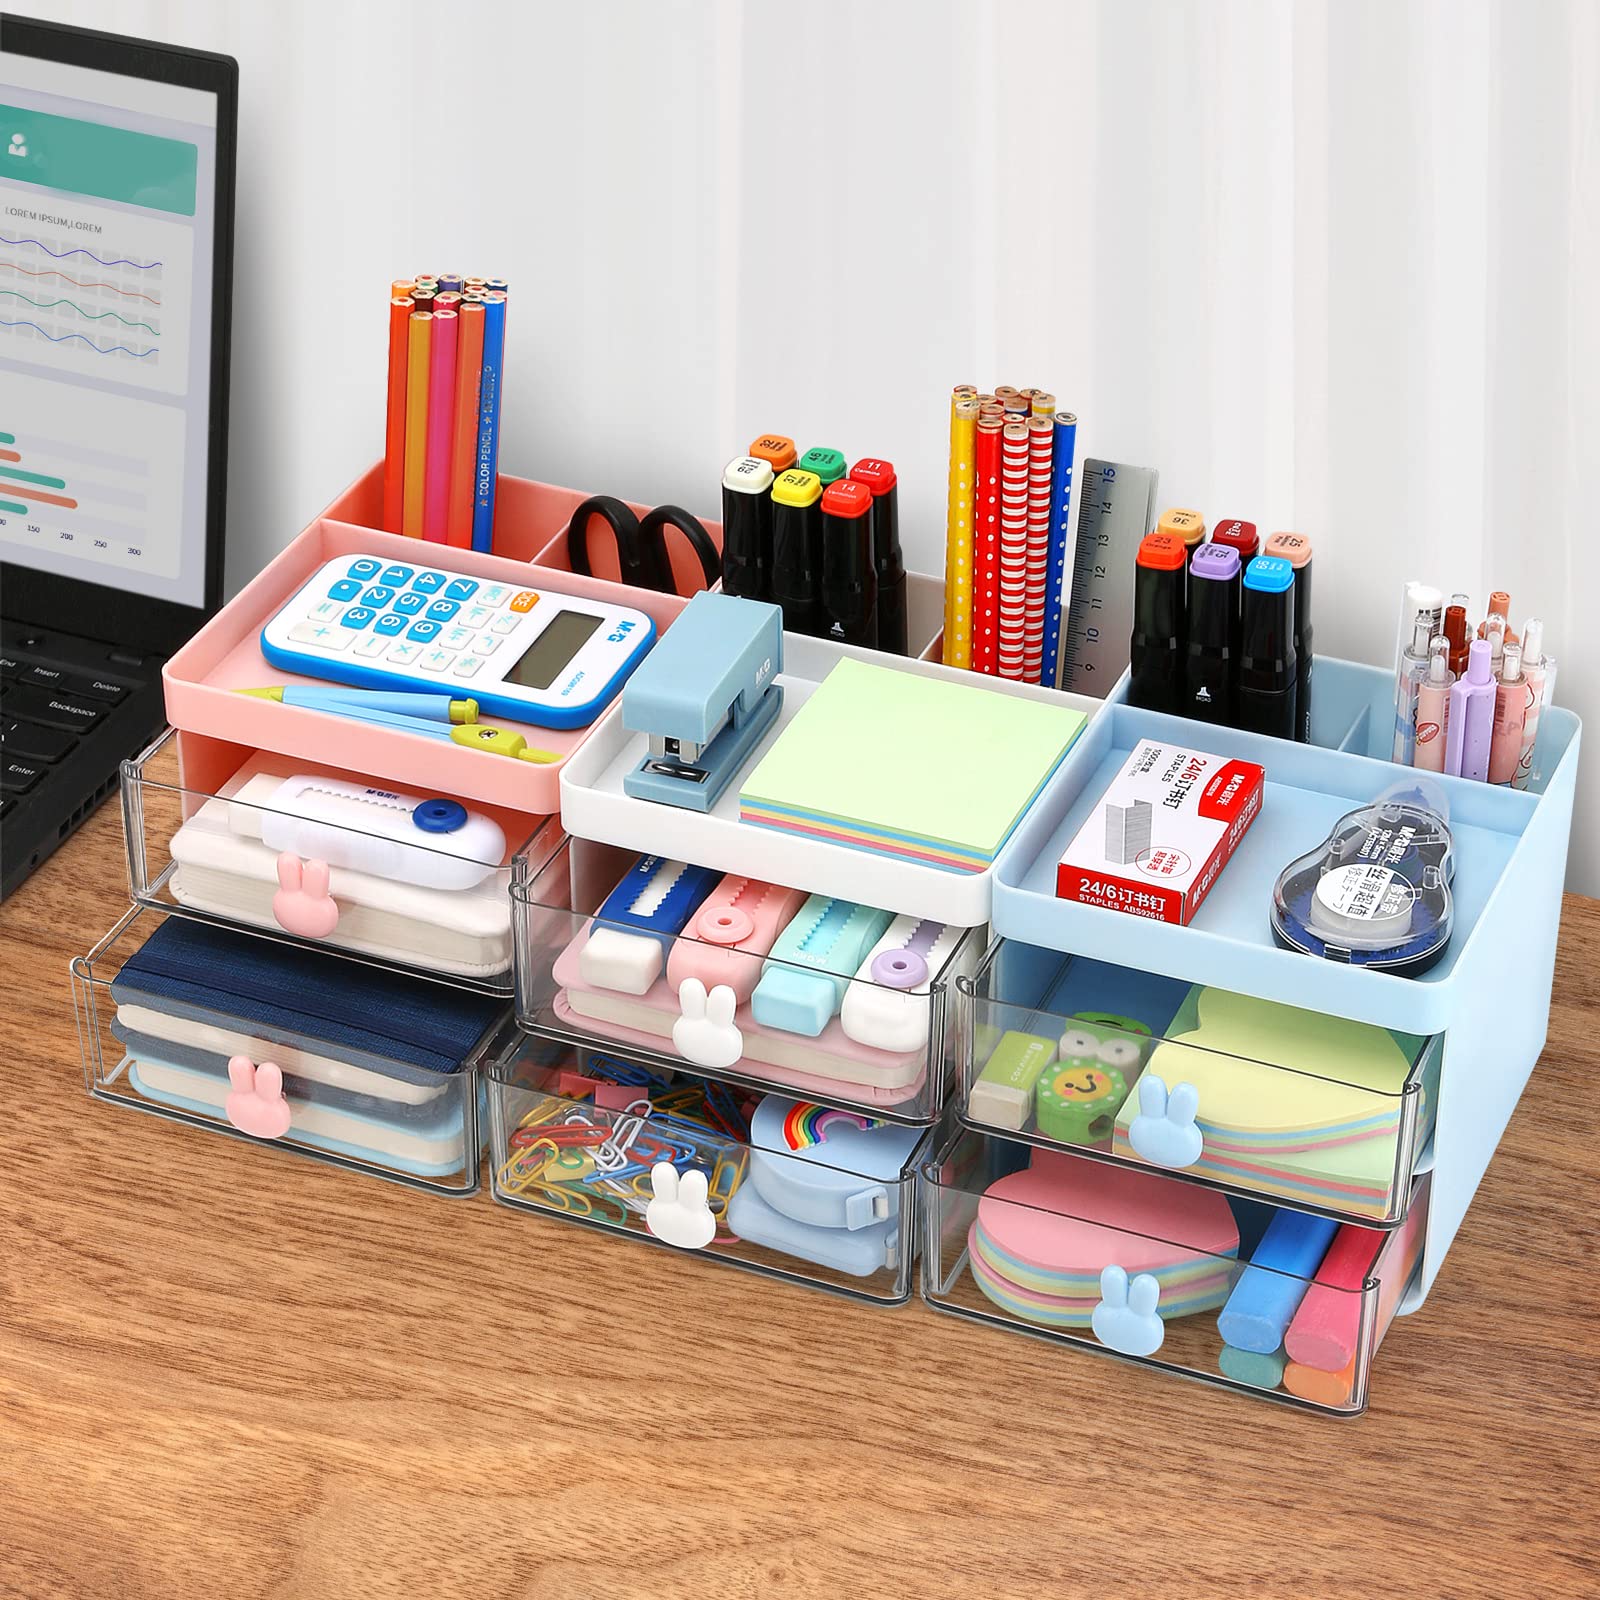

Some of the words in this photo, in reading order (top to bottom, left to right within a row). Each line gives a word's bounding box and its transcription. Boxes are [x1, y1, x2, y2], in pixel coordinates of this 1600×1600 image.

[5, 206, 36, 220] LOREM
[481, 427, 493, 461] PENCIL
[867, 461, 881, 470] 11
[479, 463, 490, 496] COLOR
[1102, 467, 1116, 484] 15
[841, 483, 856, 492] 14
[1101, 502, 1113, 515] 14
[27, 524, 40, 534] 150
[59, 532, 74, 541] 200
[93, 539, 107, 549] 250
[127, 547, 141, 556] 300
[1098, 534, 1109, 547] 13
[1289, 538, 1304, 548] 25
[1215, 549, 1230, 559] 75
[354, 561, 373, 572] 0
[1095, 565, 1106, 579] 12
[386, 569, 404, 579] 1
[419, 574, 436, 585] 4
[454, 581, 473, 593] 7
[366, 588, 387, 600] 2
[400, 594, 419, 607] 5
[433, 602, 453, 613] 8
[1092, 598, 1103, 610] 11
[348, 609, 368, 621] 3
[381, 616, 400, 627] 6
[414, 623, 434, 634] 9
[1086, 627, 1100, 644] 10
[1085, 663, 1096, 672] 9
[0, 658, 16, 668] End
[34, 667, 60, 678] Insert
[92, 681, 121, 693] Delete
[49, 700, 96, 718] Backspace
[8, 764, 36, 776] Enter
[1161, 753, 1187, 783] STAPLES
[1162, 757, 1208, 810] 24/6订书钉
[1079, 878, 1166, 912] 24/6订书钉
[1347, 867, 1388, 917] 丝滑超值
[1079, 894, 1119, 910] STAPLES
[1123, 904, 1165, 921] ABS92616
